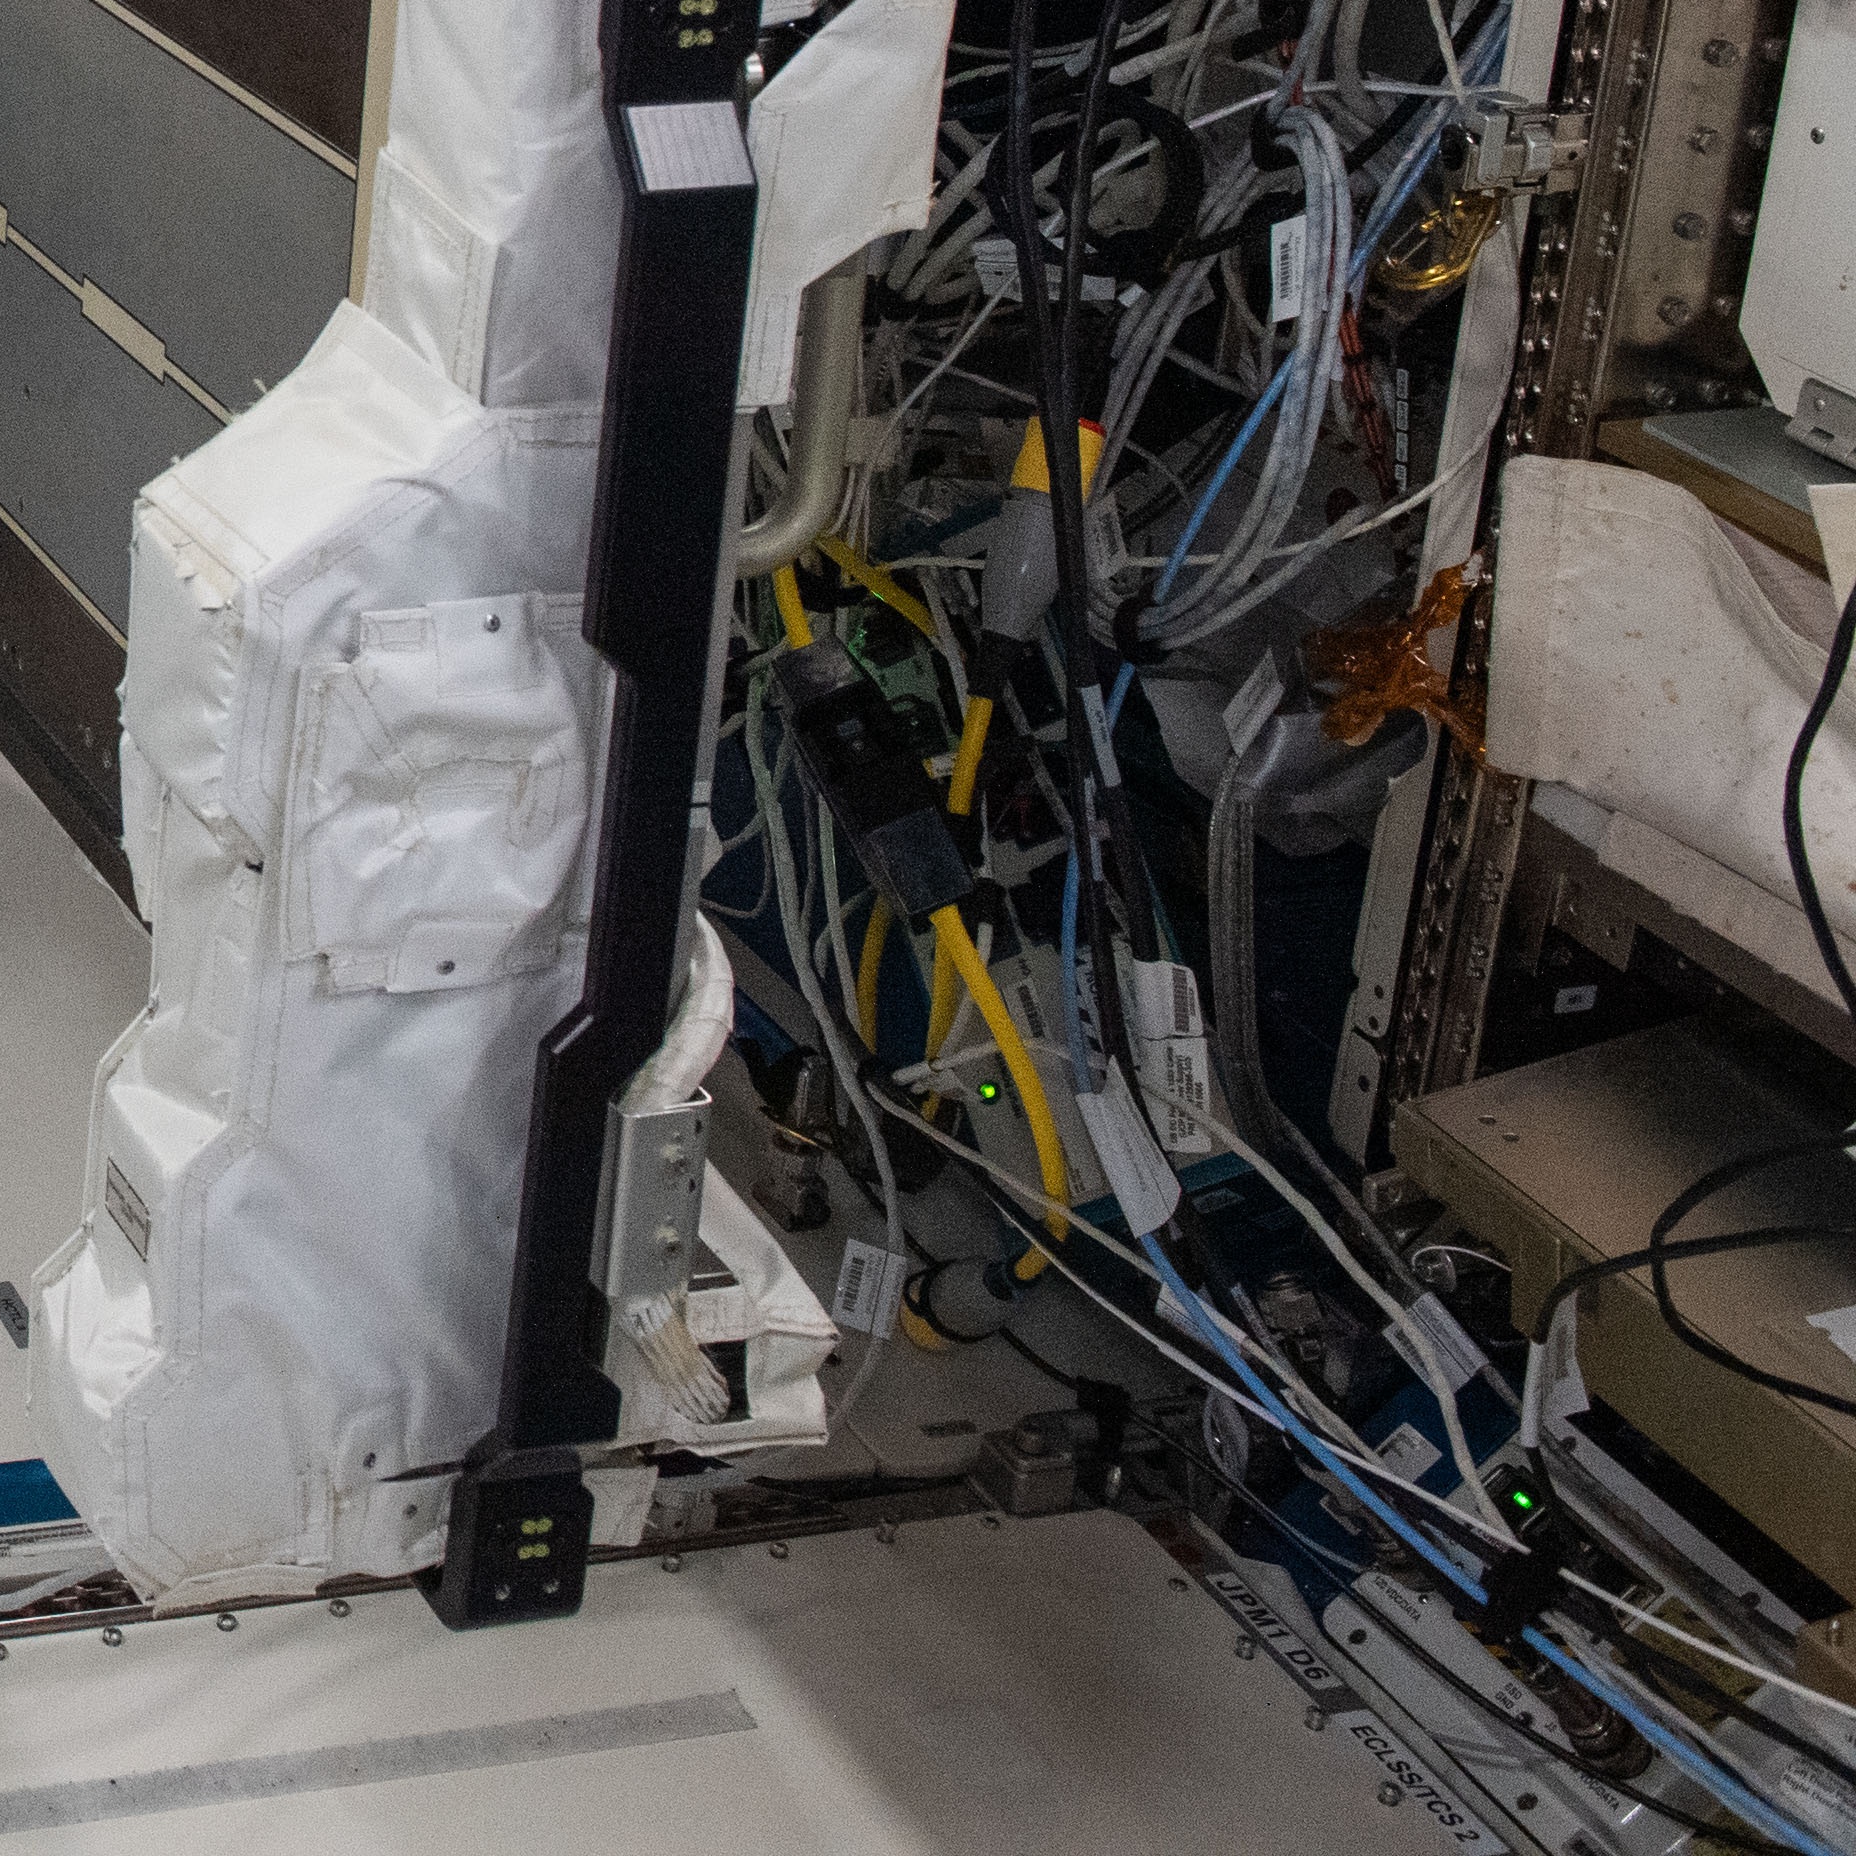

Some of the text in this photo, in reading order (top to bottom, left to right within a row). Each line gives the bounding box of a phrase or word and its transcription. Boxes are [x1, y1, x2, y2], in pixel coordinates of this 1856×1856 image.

[1386, 1587, 1421, 1622] VDC/DATA
[1216, 1580, 1330, 1681] JPM1 D6
[1494, 1691, 1514, 1709] GND
[1504, 1682, 1523, 1700] ESD
[1349, 1724, 1480, 1843] ECLSS/TCS 2
